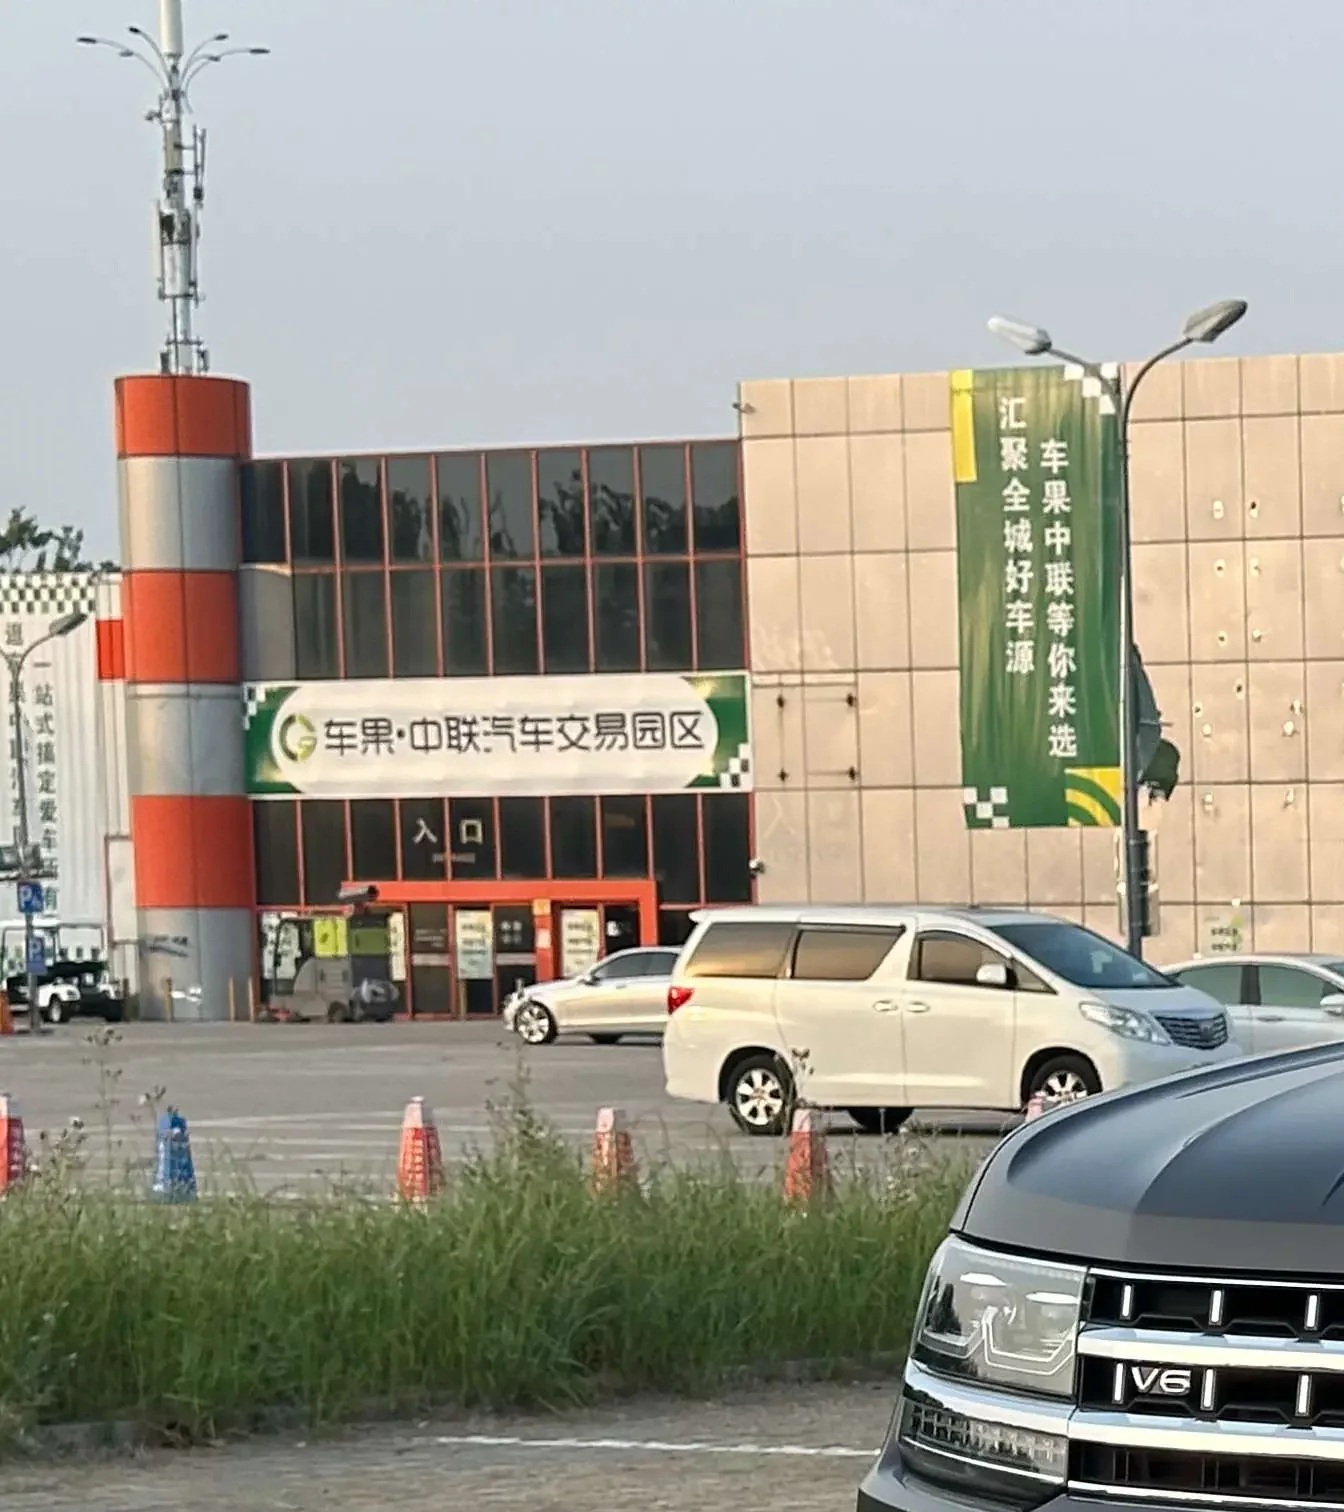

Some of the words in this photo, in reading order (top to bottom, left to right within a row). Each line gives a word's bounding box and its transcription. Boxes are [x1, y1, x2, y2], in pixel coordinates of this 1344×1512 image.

[1000, 397, 1035, 675] 汇聚全城好车源
[1040, 438, 1078, 759] 车果中联等你来选
[324, 711, 705, 757] 车果·中联汽车交易园区
[412, 817, 483, 846] 入口
[1131, 1367, 1191, 1396] V6
